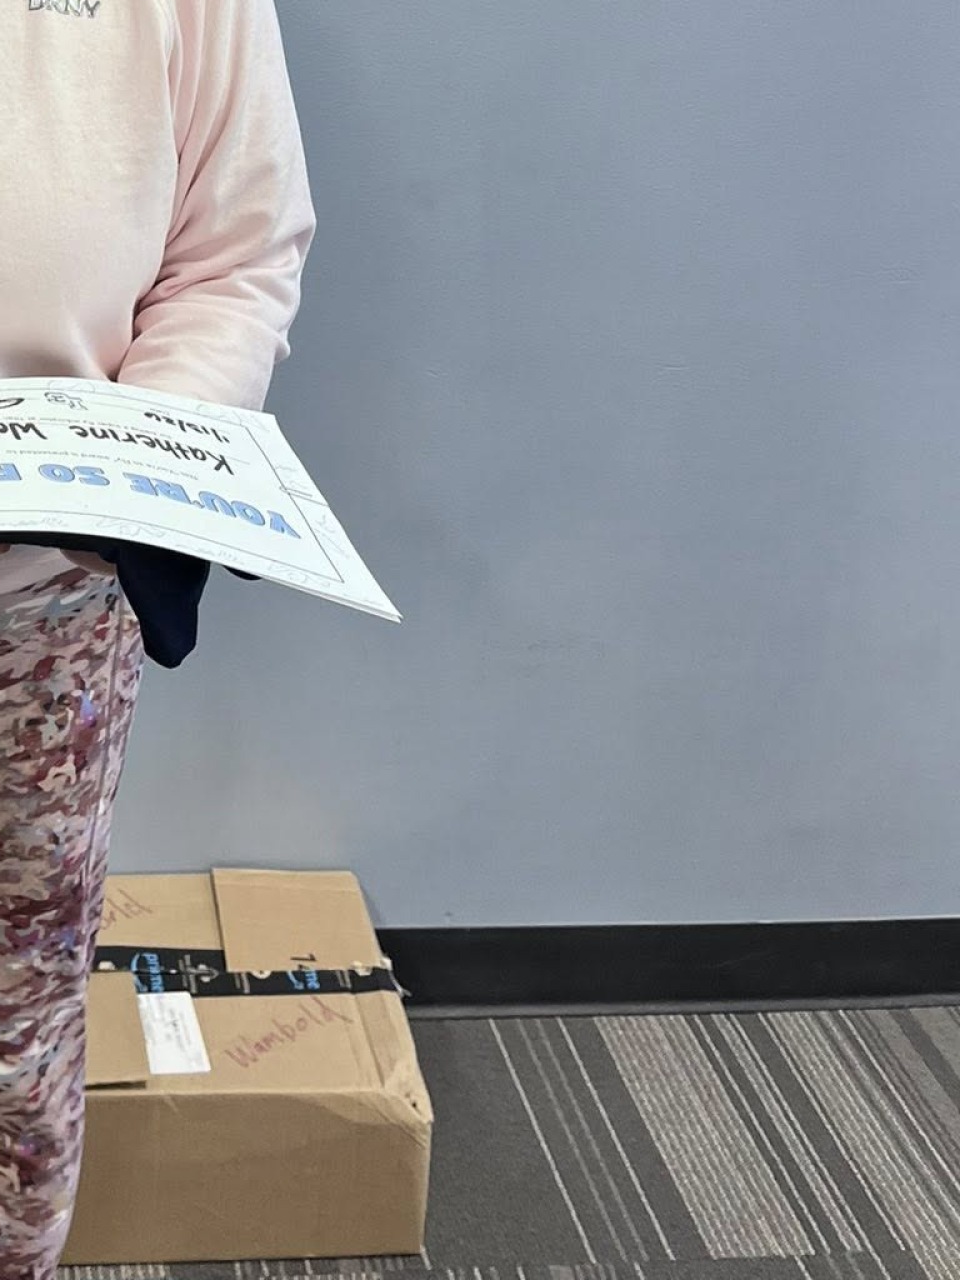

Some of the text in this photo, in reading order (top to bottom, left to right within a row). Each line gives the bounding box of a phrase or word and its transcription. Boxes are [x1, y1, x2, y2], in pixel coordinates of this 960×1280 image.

[40, 462, 111, 486] SO
[69, 425, 235, 476] Katherine
[130, 472, 301, 539] YOU'RE
[222, 995, 354, 1069] Wambold
